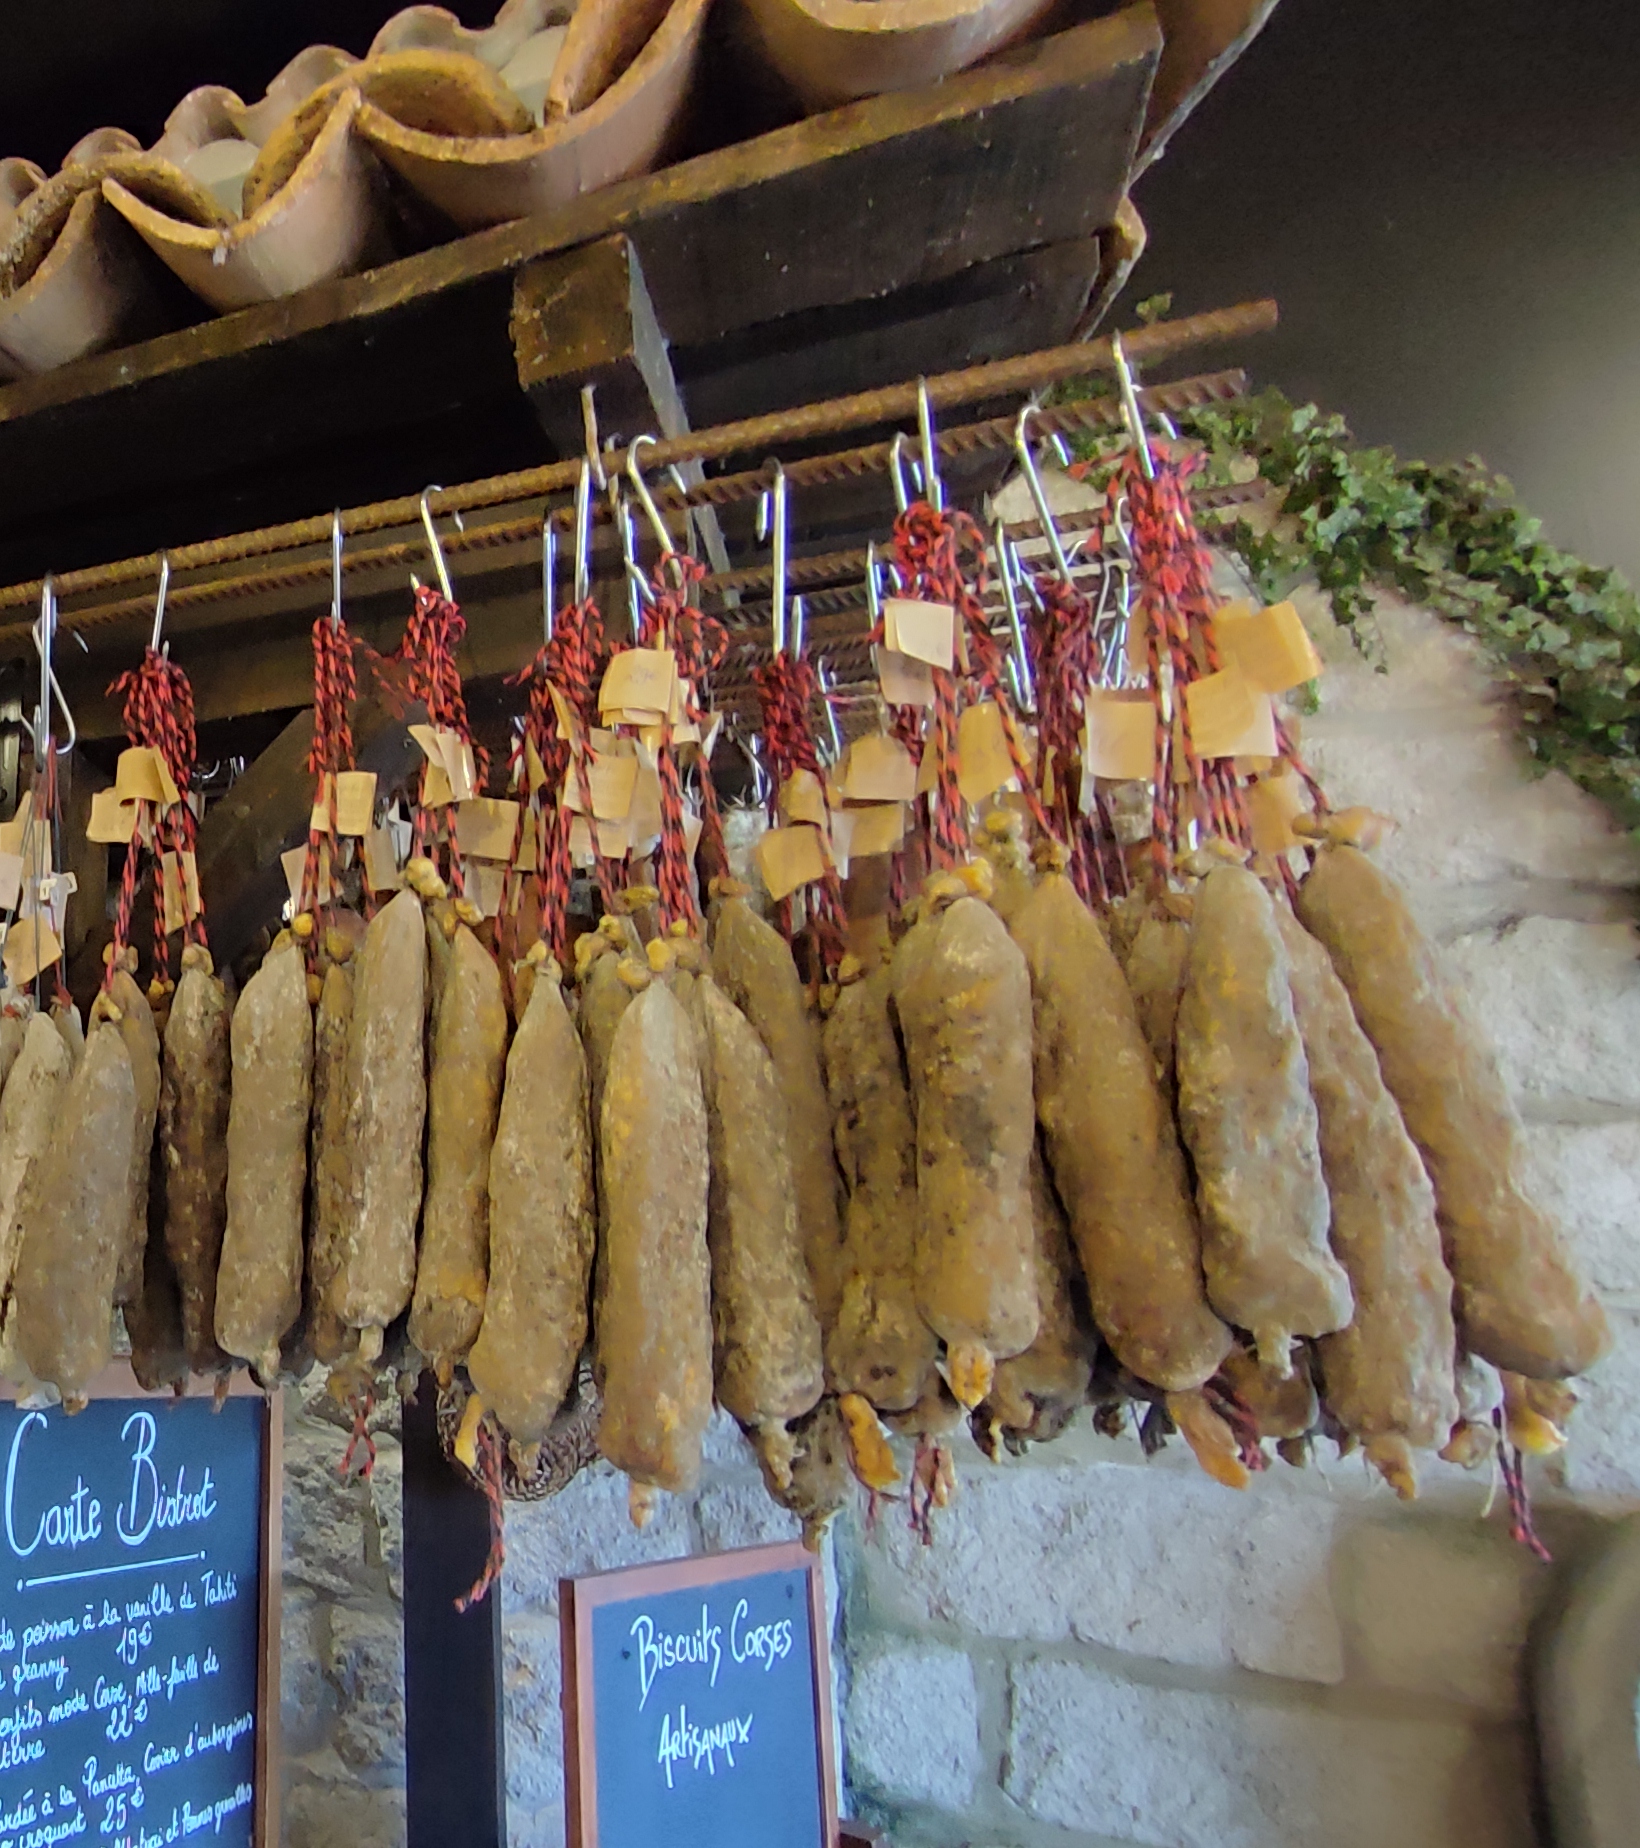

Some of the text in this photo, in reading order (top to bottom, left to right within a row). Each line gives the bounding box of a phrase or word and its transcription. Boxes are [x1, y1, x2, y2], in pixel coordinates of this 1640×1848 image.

[5, 1411, 217, 1556] Carte Bistrot
[21, 1618, 80, 1668] poisson
[83, 1603, 95, 1630] à
[98, 1599, 121, 1627] la
[126, 1582, 174, 1622] vanille
[179, 1581, 196, 1609] de
[201, 1570, 237, 1607] Tahiti
[12, 1655, 69, 1696] granny
[116, 1621, 152, 1665] 19€
[47, 1688, 90, 1723] mode
[204, 1646, 219, 1674] de
[630, 1603, 721, 1711] Biscuits
[106, 1698, 148, 1741] 22€
[41, 1791, 54, 1816] à
[59, 1784, 76, 1806] la
[100, 1786, 145, 1833] 25€
[166, 1807, 179, 1843] et
